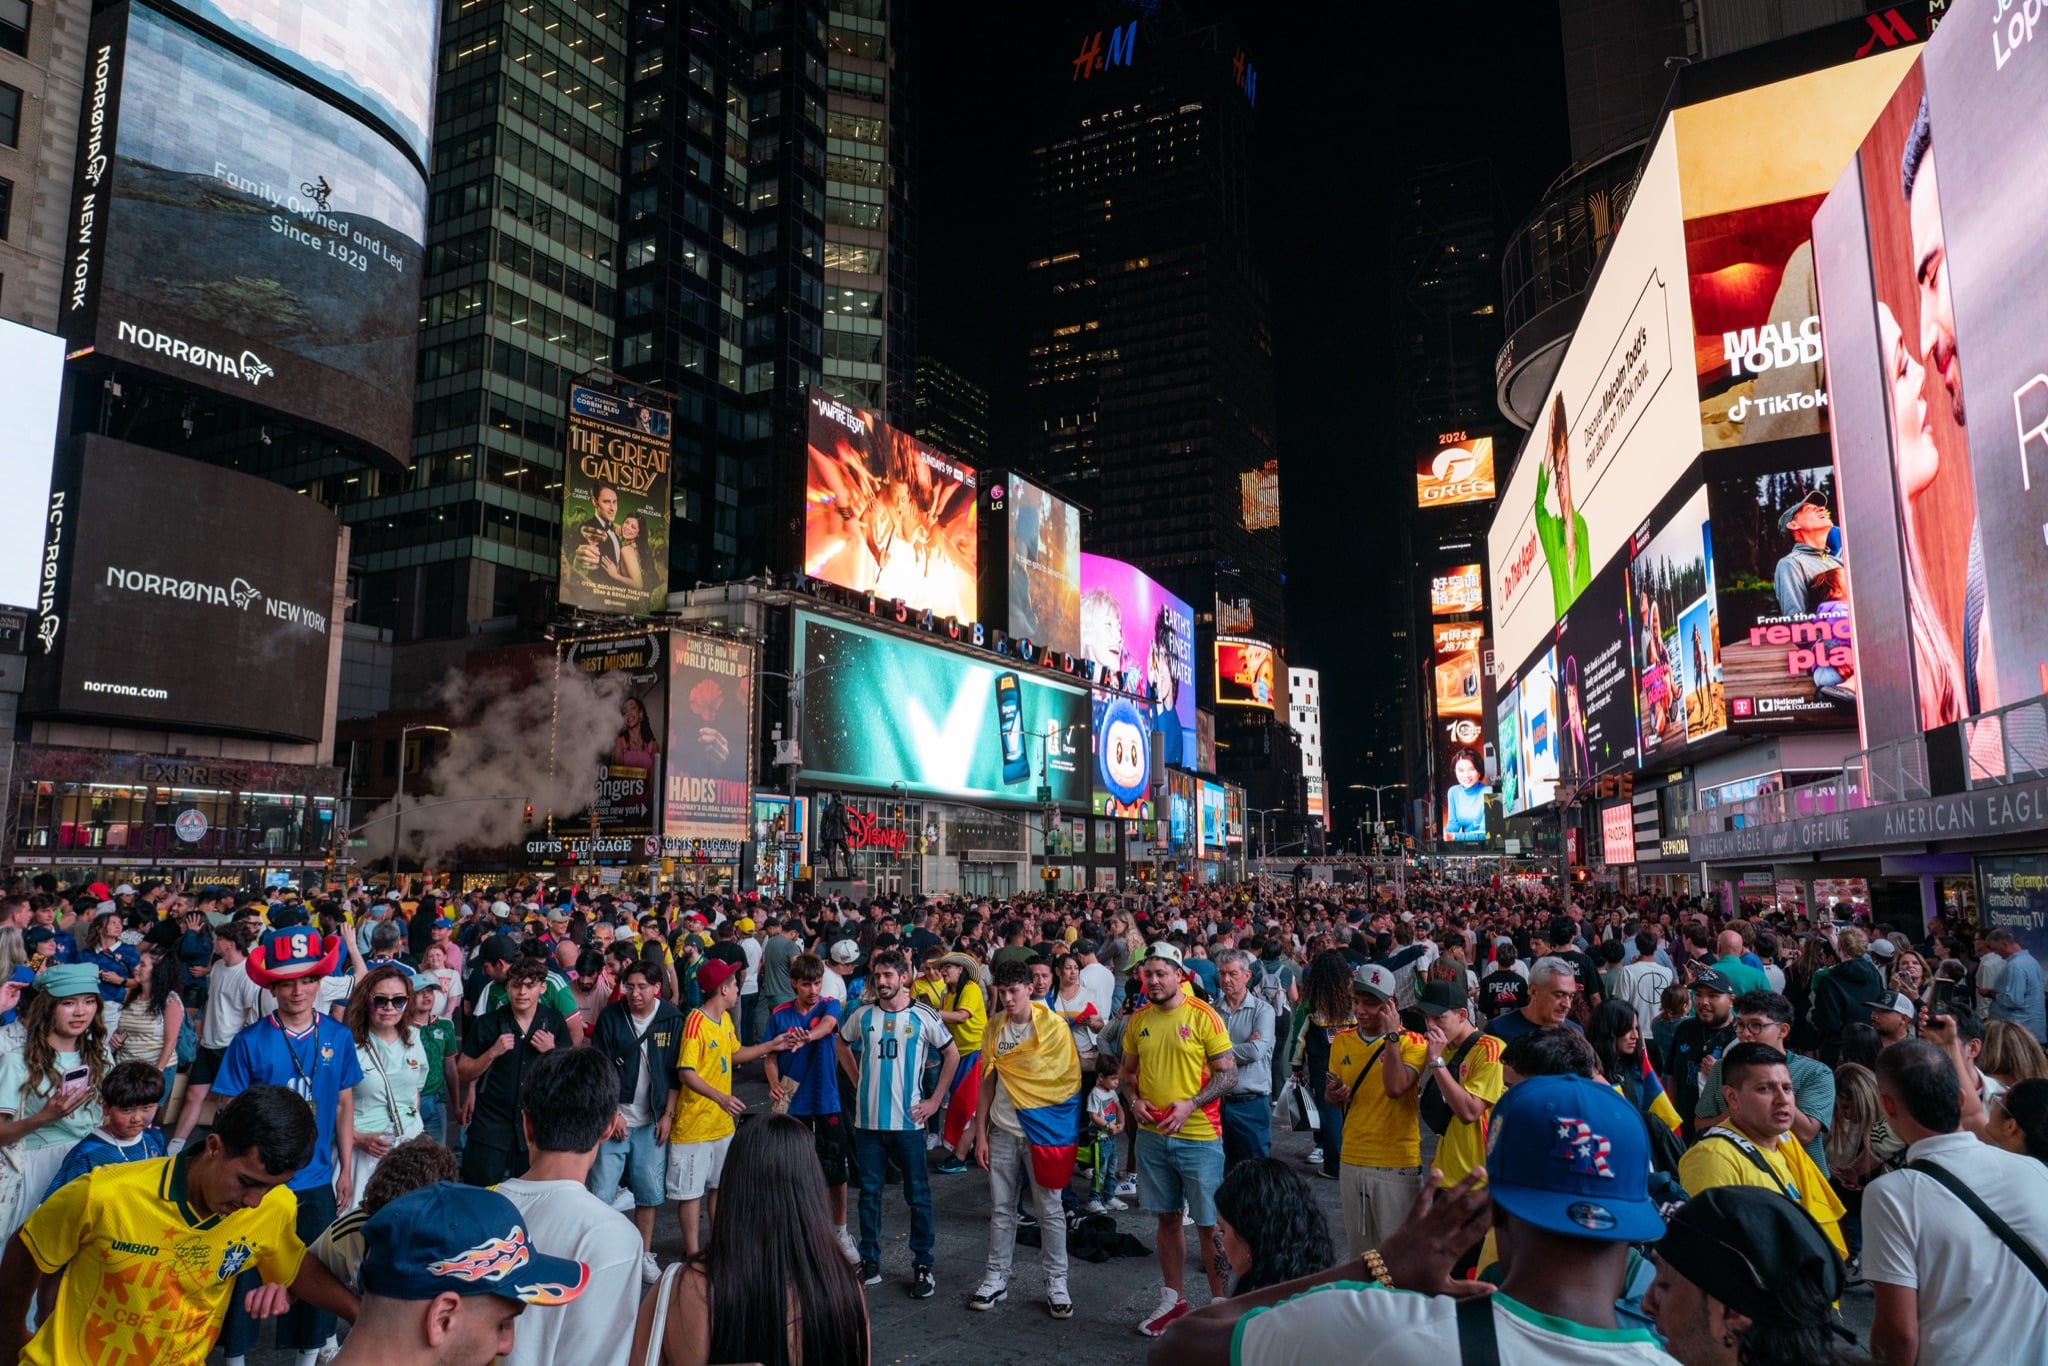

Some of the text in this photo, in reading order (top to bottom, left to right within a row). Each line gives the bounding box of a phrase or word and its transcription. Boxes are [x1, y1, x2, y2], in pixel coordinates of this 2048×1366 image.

[1072, 20, 1137, 81] H&M
[1233, 48, 1256, 109] H&M
[71, 45, 111, 312] NORRØNA NEW YORK
[214, 161, 403, 273] Family Owned and Led
[270, 214, 368, 272] Since 1929
[118, 320, 240, 379] NORRØNA
[1724, 337, 1823, 376] TODD
[1584, 326, 1647, 448] Discover Malcolm Todd's
[576, 398, 620, 415] CORBIN BLEU
[594, 397, 618, 407] STARRING
[818, 399, 846, 427] VAMPIRE
[1754, 389, 1828, 416] TikTok
[1596, 424, 1610, 457] album
[1609, 412, 1618, 434] on
[1616, 380, 1635, 421] TikTok
[570, 416, 670, 449] THE PARTY'S ROARING ON BROADWAY
[1439, 431, 1467, 444] 2026
[570, 428, 670, 474] THE GREAT
[920, 451, 953, 476] SUNDAYS 9P
[580, 455, 658, 491] GATSBY
[1423, 480, 1484, 499] GREE
[991, 501, 1003, 510] LG
[1504, 530, 1537, 602] Do That Again
[1433, 574, 1478, 591] 好空调
[106, 566, 326, 635] NORRØNA NEW YORK
[865, 589, 960, 639] 1540
[1164, 604, 1191, 639] EARTH'S
[1757, 615, 1791, 625] From
[1793, 612, 1816, 622] the
[686, 640, 739, 661] COME SEE HOW THE
[1169, 631, 1191, 662] FINEST
[604, 652, 644, 670] MUSICAL
[675, 649, 749, 678] WORLD COULD BE
[1170, 656, 1192, 686] WATER
[84, 679, 168, 700] norrona.com
[1773, 697, 1805, 705] National
[141, 762, 249, 788] EXPRESS
[669, 775, 747, 806] HADESTOWN
[610, 806, 623, 814] new
[624, 804, 640, 816] york
[1885, 789, 2048, 836] AMERICAN EAGL
[527, 841, 561, 853] GIFTS
[665, 837, 741, 851] GIFTS LUGGAGE
[1662, 839, 1689, 856] SEPHORA
[1700, 836, 1734, 855] AMERICAN
[1738, 832, 1761, 852] EAGLE
[1803, 818, 1850, 845] OFFLINE
[193, 876, 240, 885] LUGGAGE
[1987, 873, 2012, 891] Target
[1990, 893, 2026, 907] emails on
[1991, 911, 2045, 930] Streaming TV
[274, 933, 322, 961] USA
[1488, 982, 1520, 993] PEAK
[878, 1038, 898, 1060] 10
[111, 1240, 160, 1257] UMBRO
[113, 1308, 152, 1330] CBF
